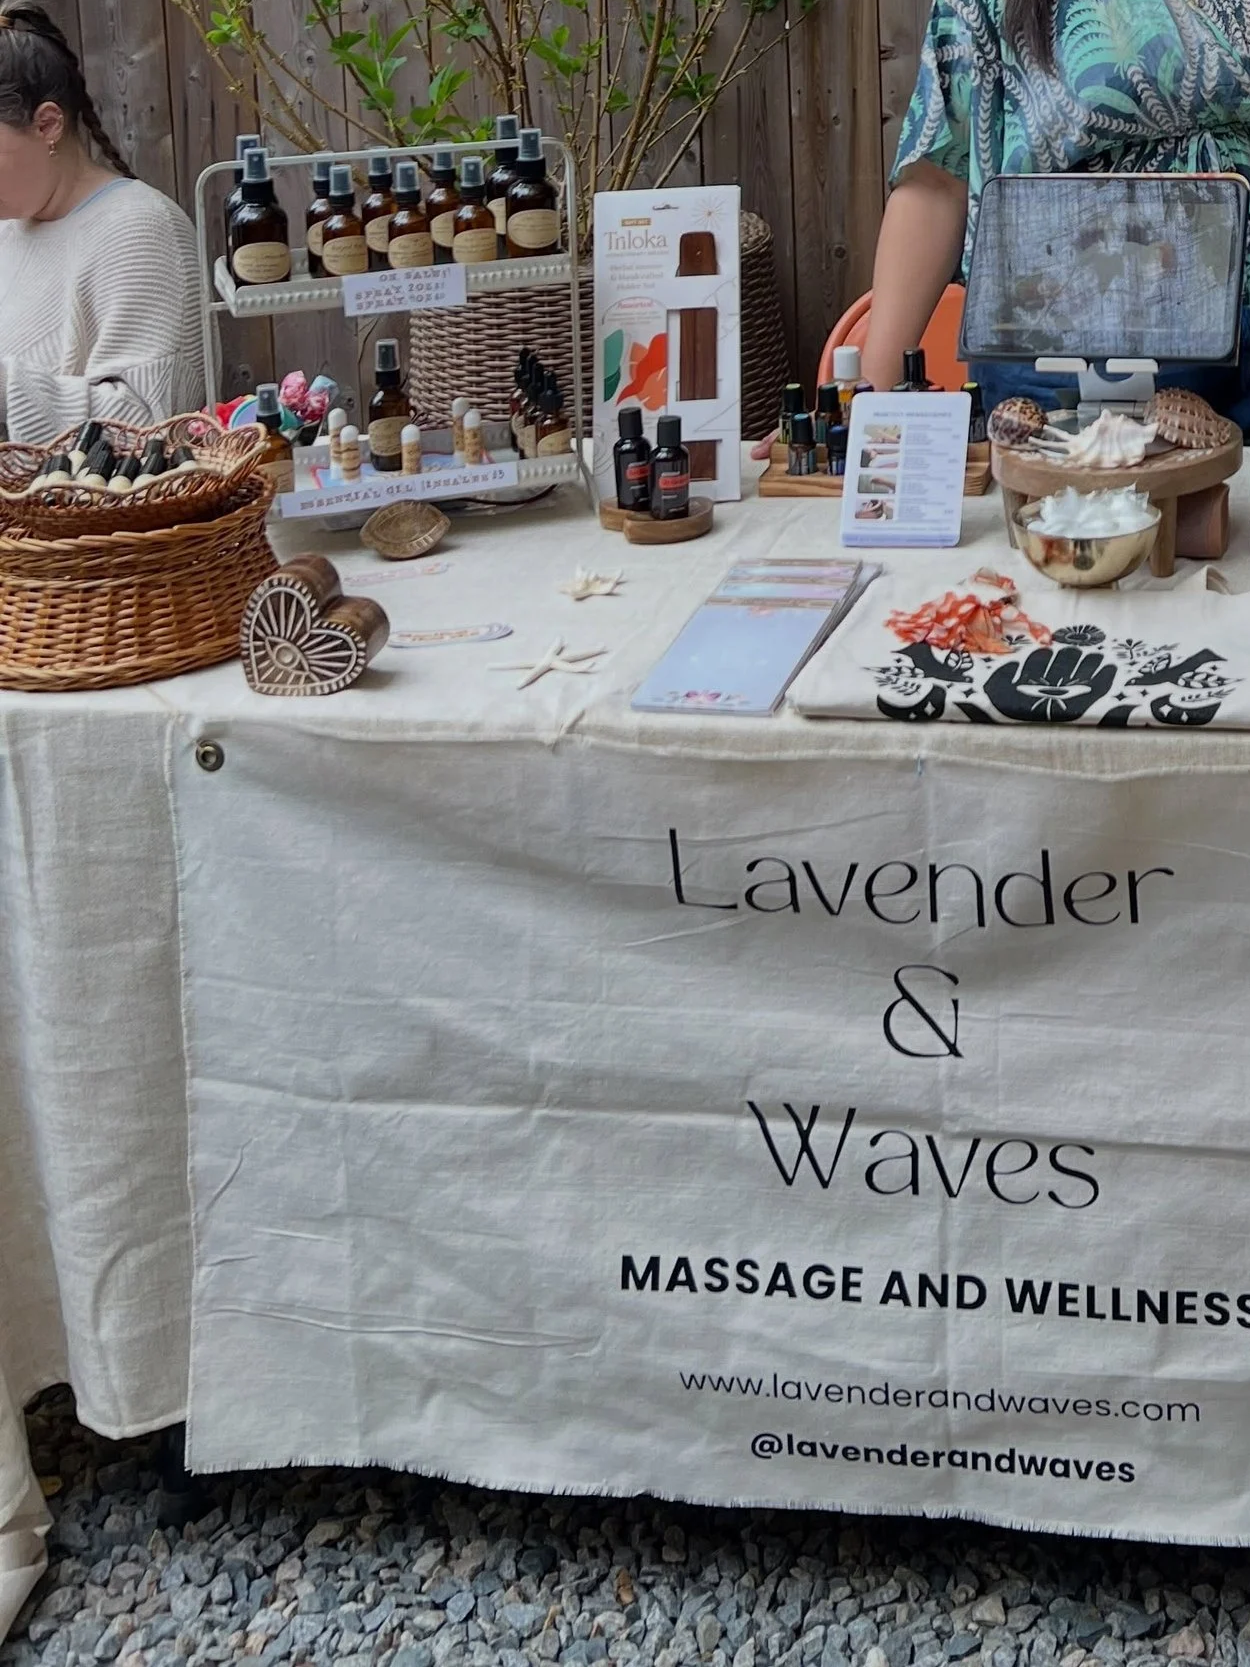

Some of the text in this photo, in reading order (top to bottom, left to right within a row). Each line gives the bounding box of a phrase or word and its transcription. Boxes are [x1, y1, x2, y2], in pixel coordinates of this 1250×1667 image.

[603, 229, 669, 251] Triloka
[386, 483, 414, 499] OIL
[667, 827, 1176, 928] Lavender
[882, 964, 965, 1060] &
[746, 1100, 1102, 1210] Waves
[619, 1253, 865, 1304] MASSAGE
[878, 1270, 988, 1311] AND
[678, 1367, 1202, 1425] www.lavenderandwaves.com
[749, 1430, 1137, 1485] @lavenderandwaves
